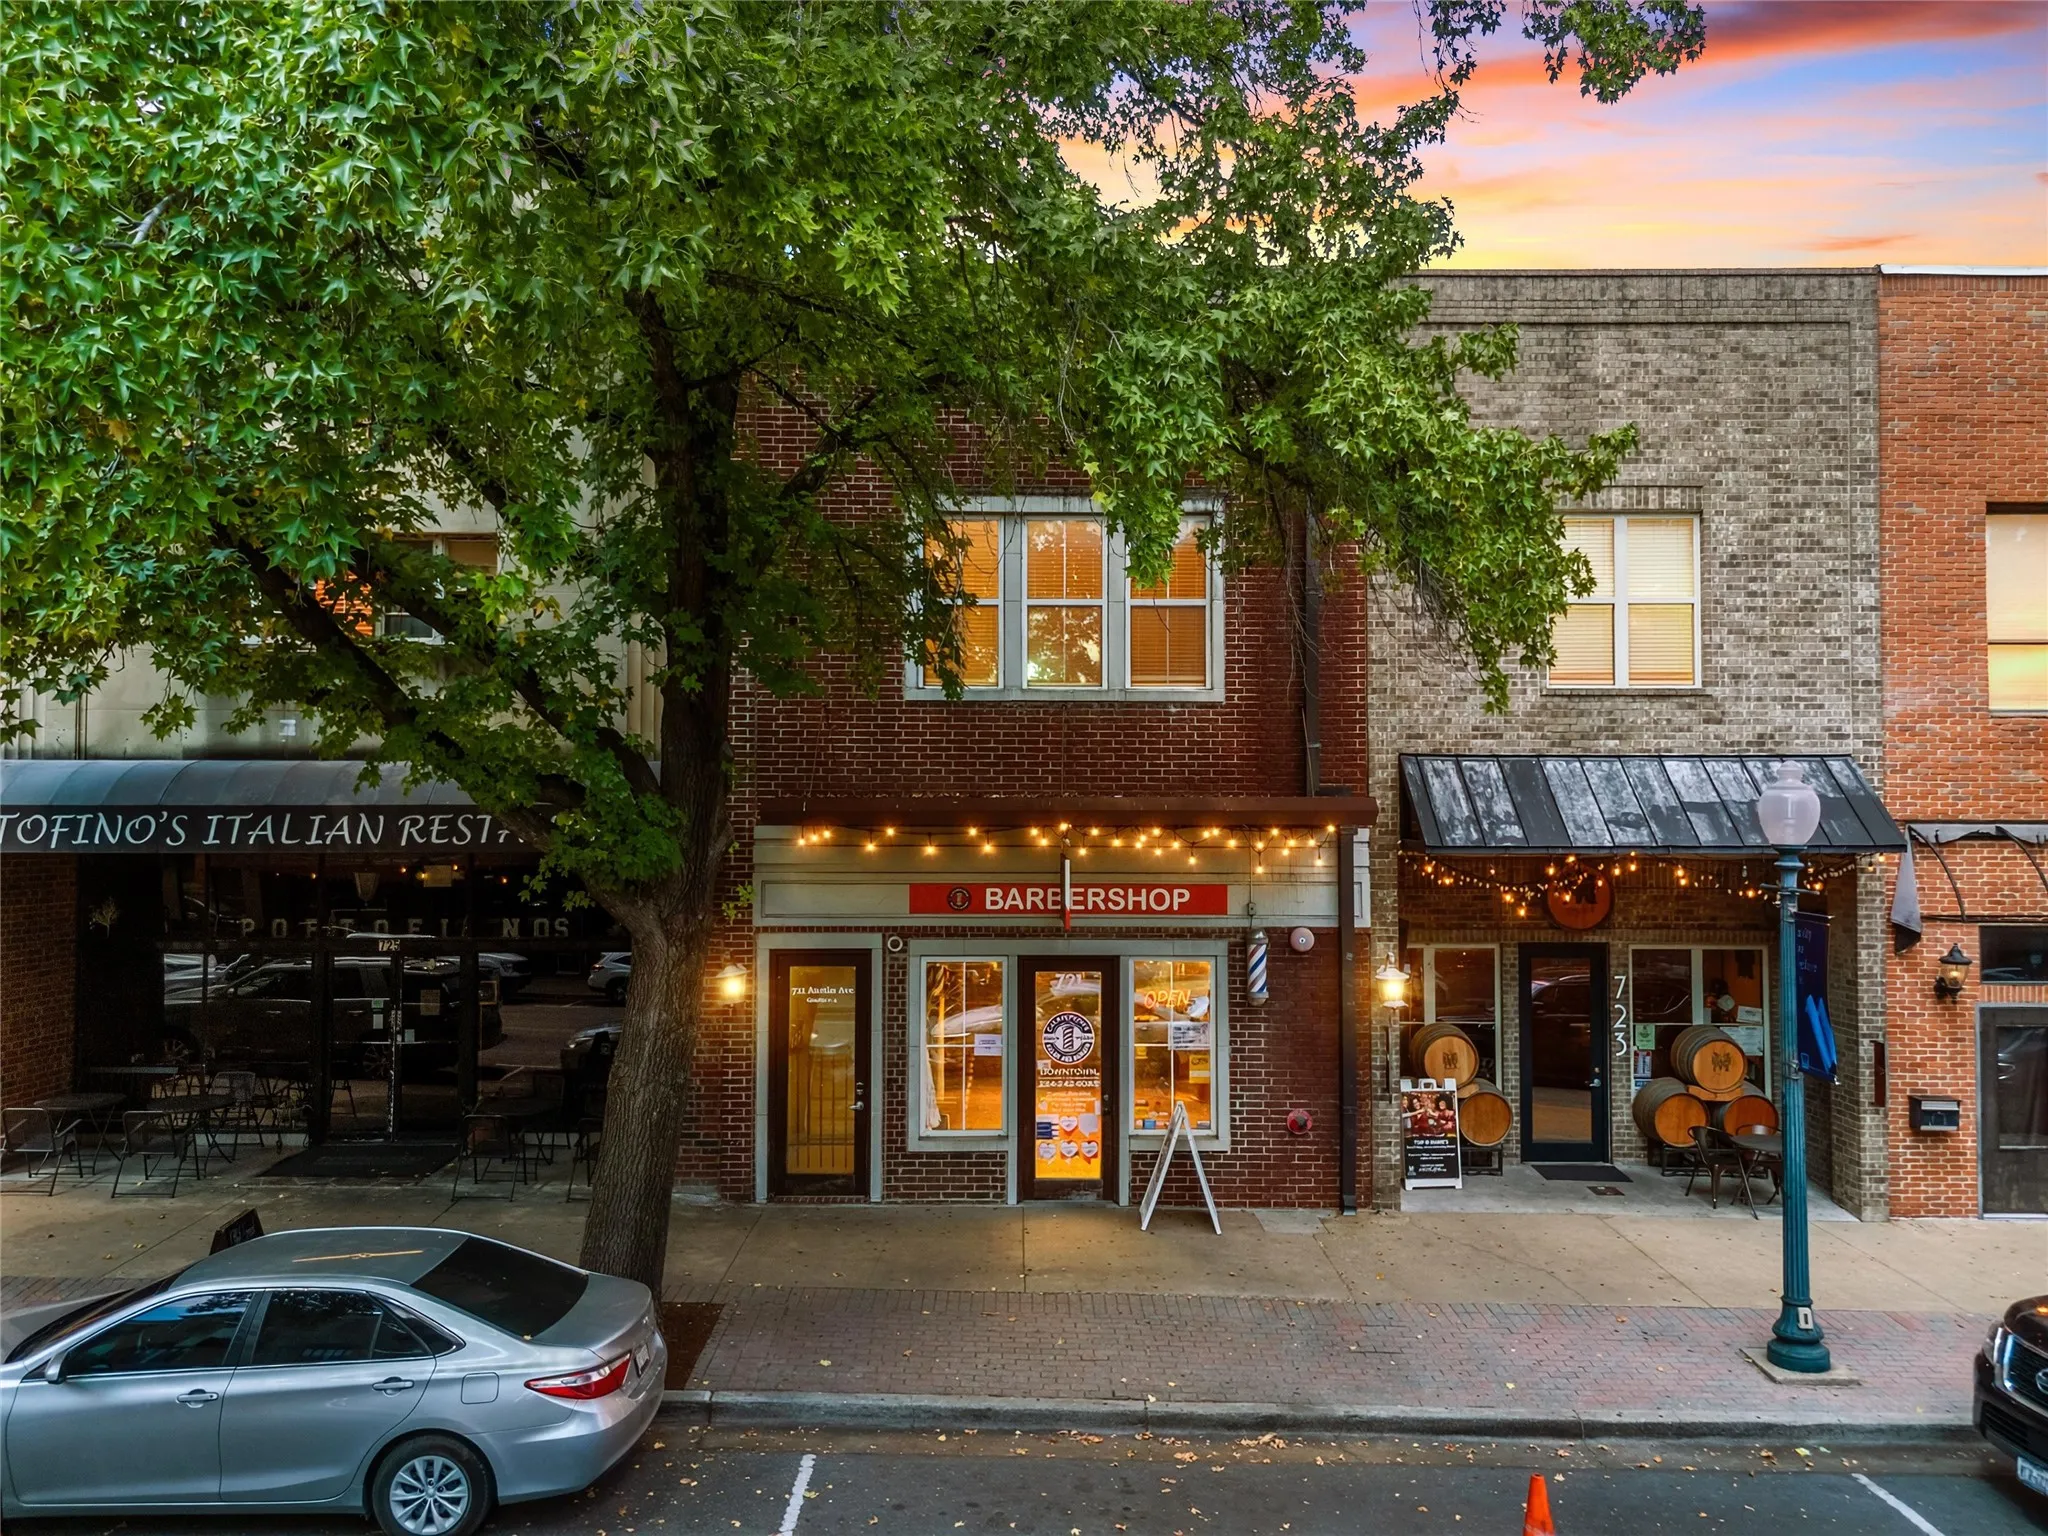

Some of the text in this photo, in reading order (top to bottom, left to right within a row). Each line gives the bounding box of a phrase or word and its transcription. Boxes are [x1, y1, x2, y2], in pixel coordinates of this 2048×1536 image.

[202, 812, 384, 845] ITALIAN
[985, 887, 1191, 911] BARBERSHOP
[1144, 989, 1192, 1010] OPEN
